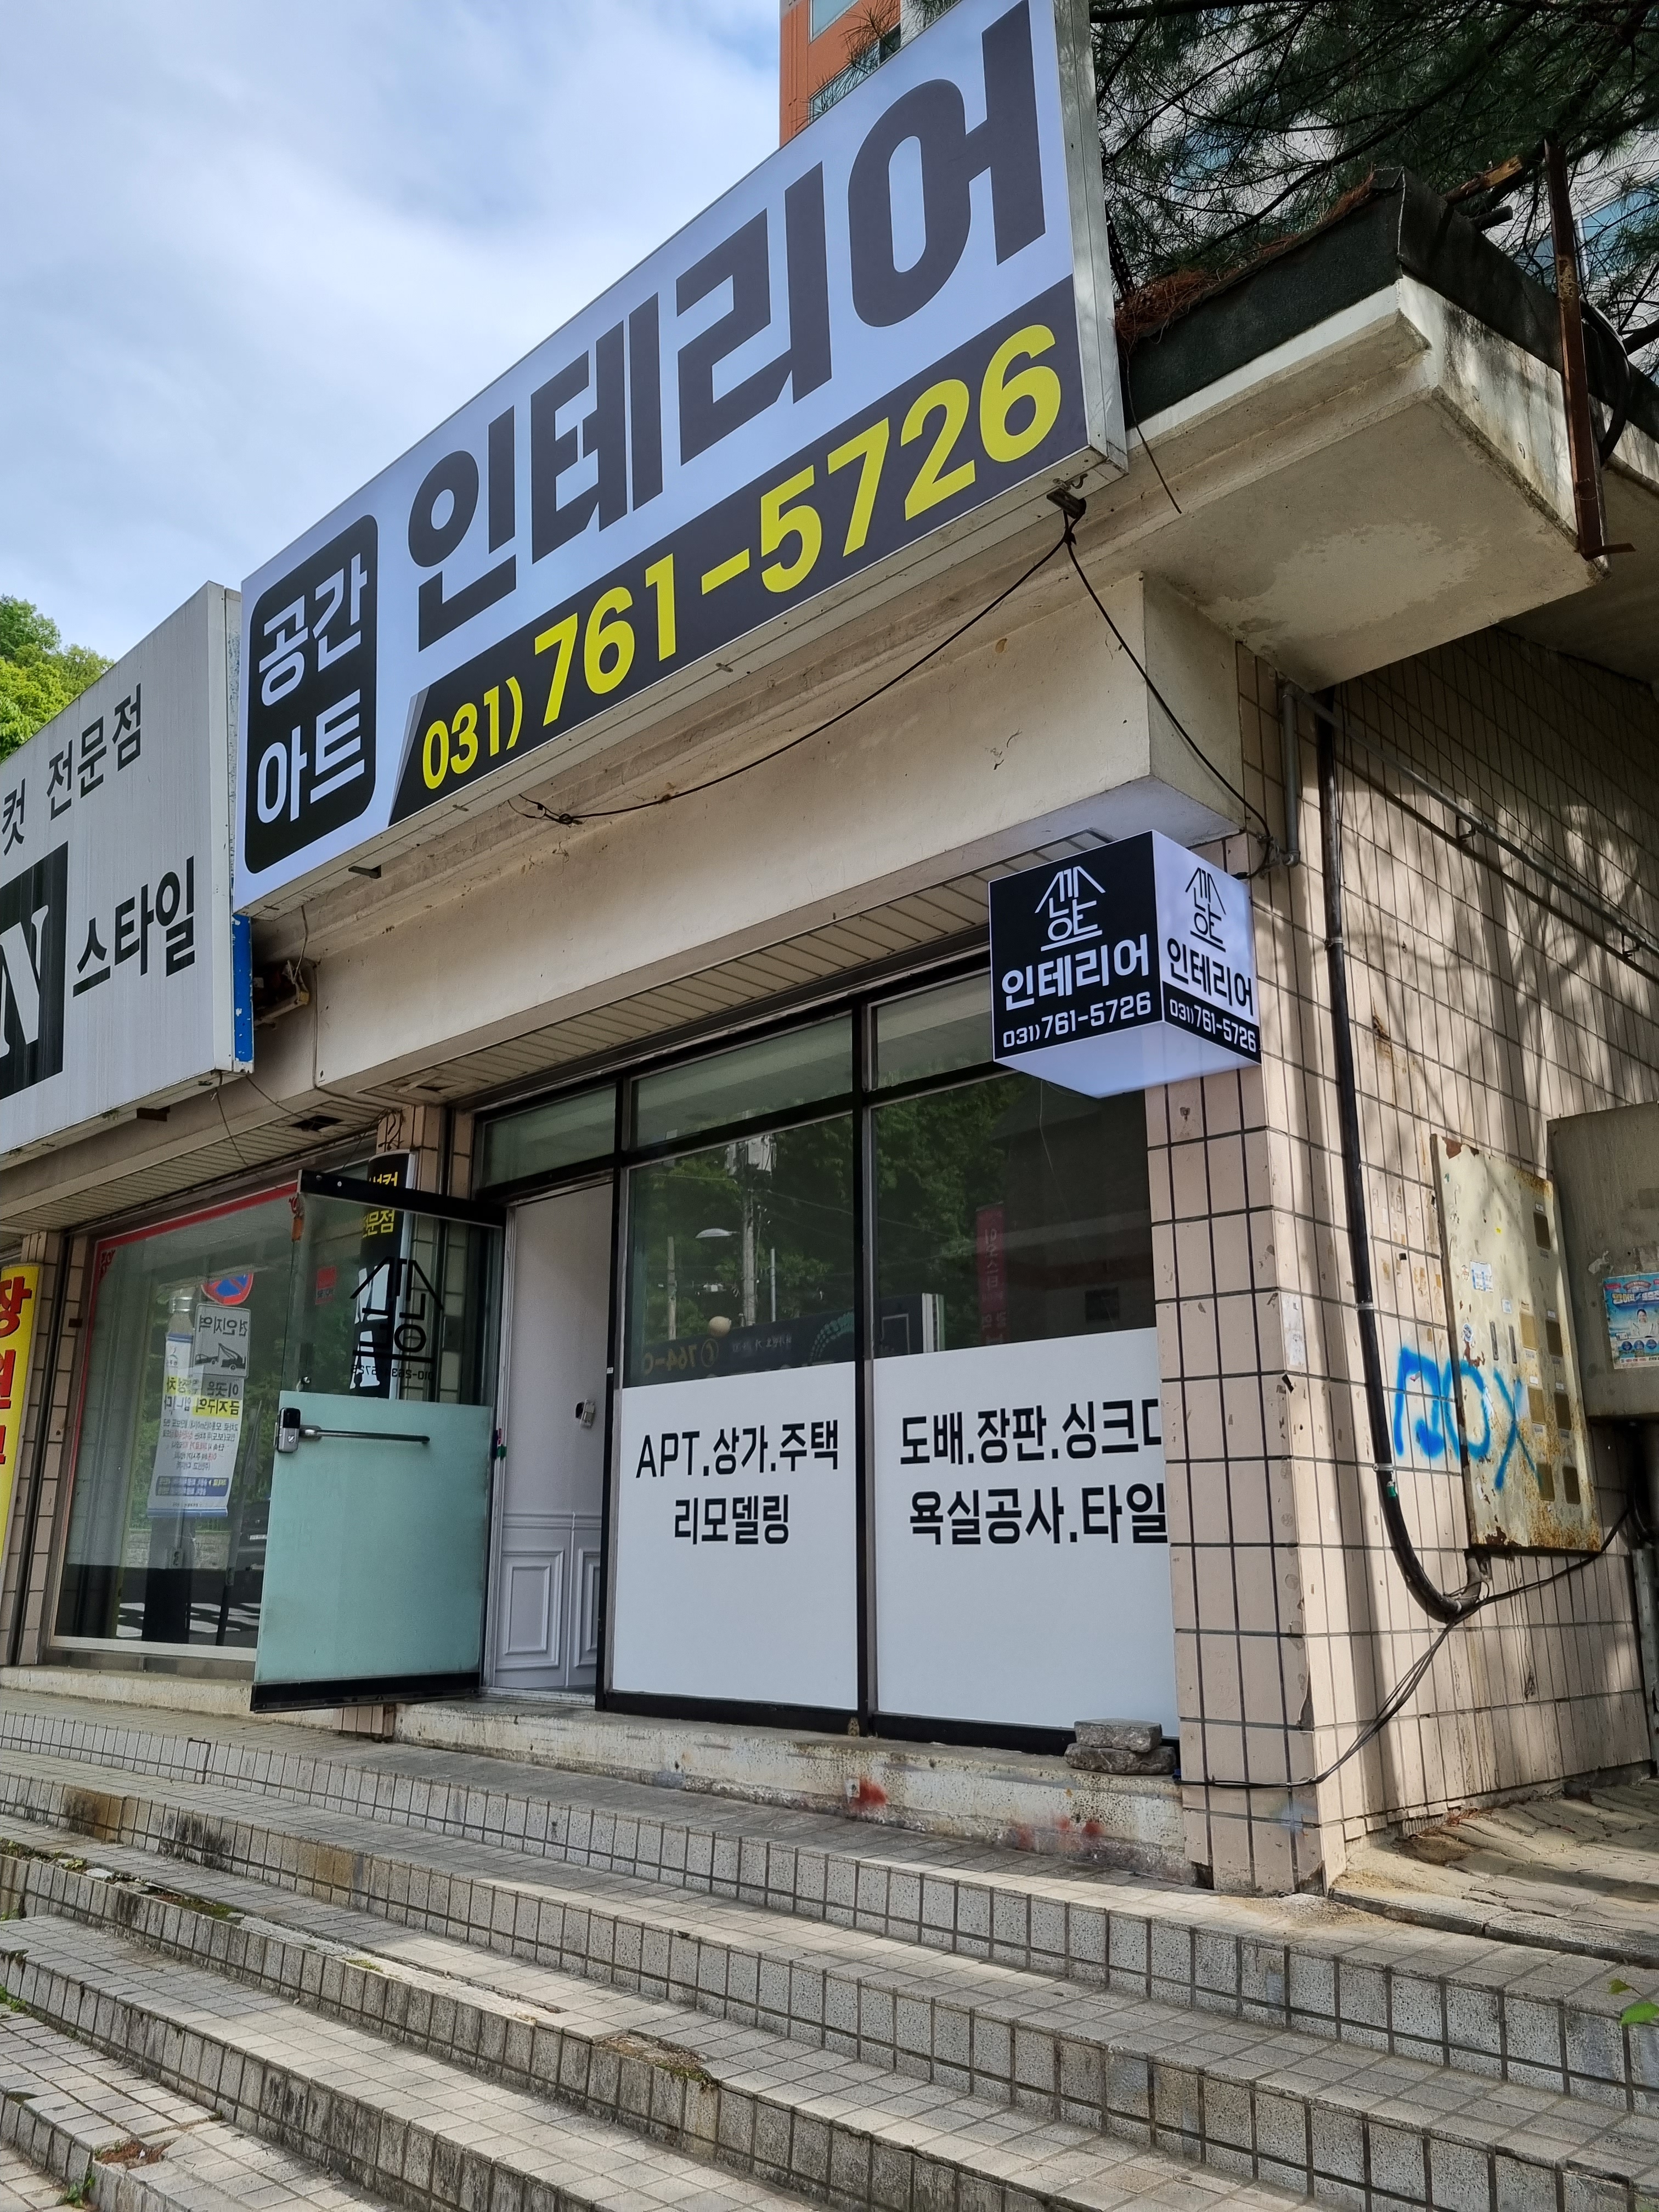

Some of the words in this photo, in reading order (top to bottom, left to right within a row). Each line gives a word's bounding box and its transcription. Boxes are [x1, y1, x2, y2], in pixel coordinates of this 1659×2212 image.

[408, 0, 1047, 651] 인테리어
[257, 552, 368, 707] 공간
[46, 682, 142, 821] 전문점
[255, 689, 367, 825] 아트
[73, 855, 196, 997] 스타일
[1002, 934, 1149, 1011] 인테리어
[1167, 938, 1254, 1017] 인테리어
[674, 1495, 789, 1545] 리모델링
[909, 1483, 1168, 1544] 욕실공사.타일
